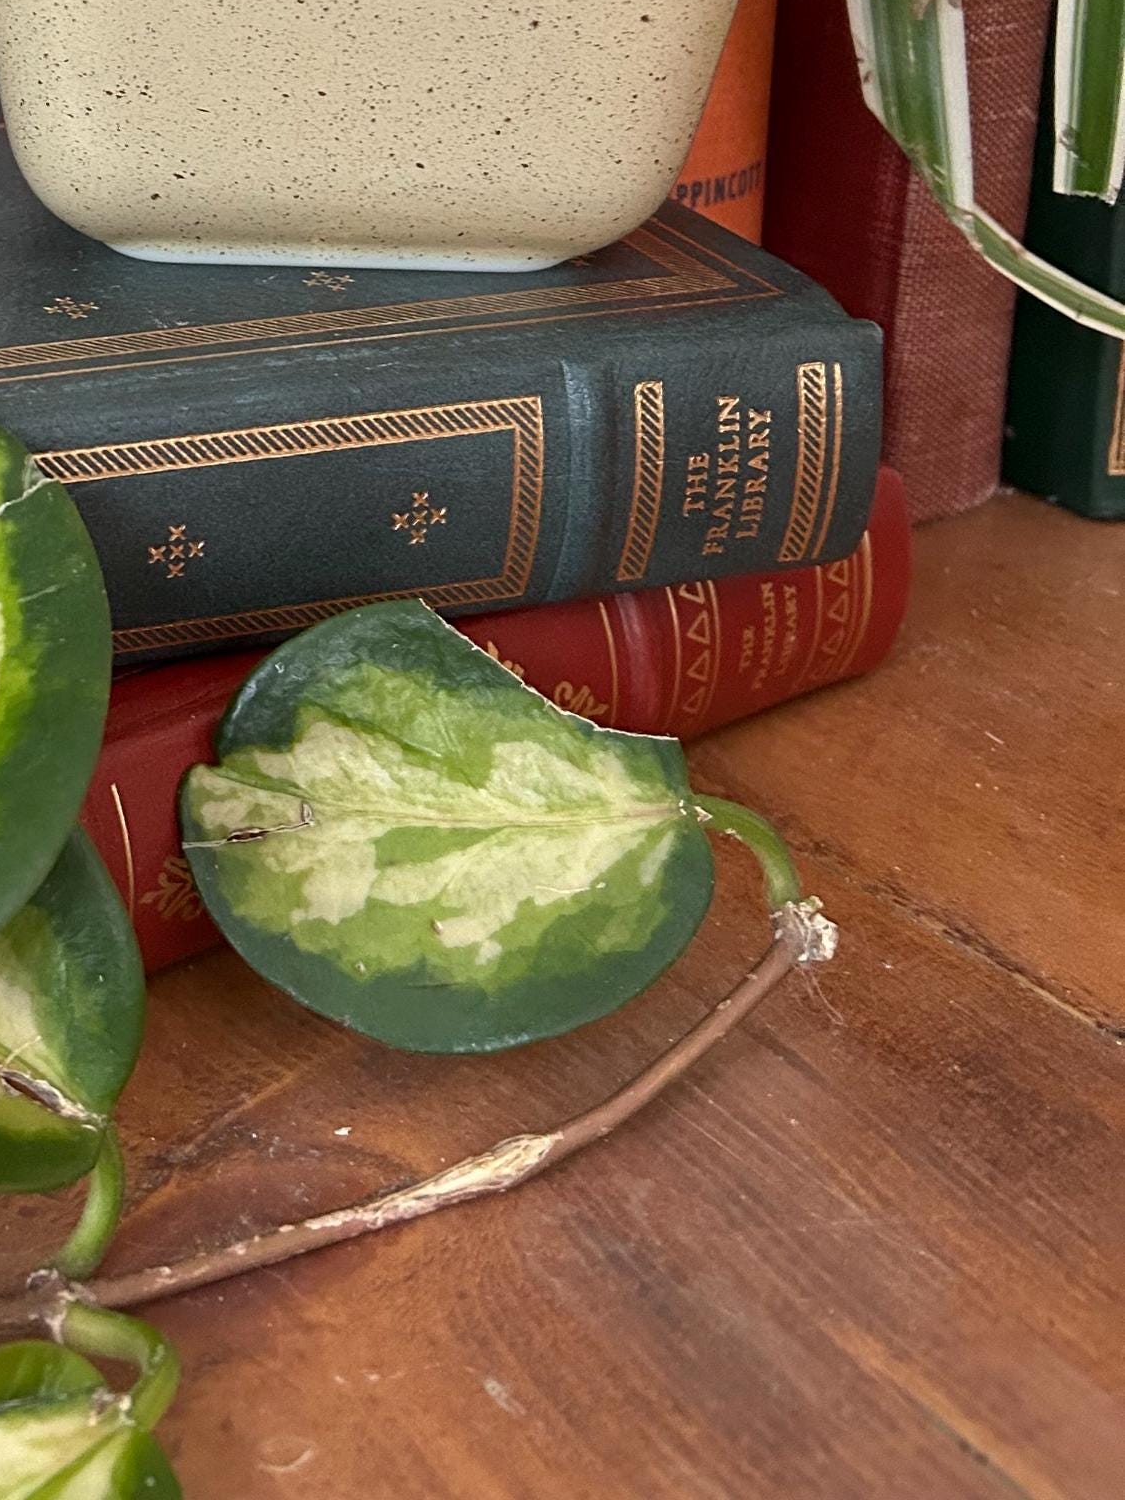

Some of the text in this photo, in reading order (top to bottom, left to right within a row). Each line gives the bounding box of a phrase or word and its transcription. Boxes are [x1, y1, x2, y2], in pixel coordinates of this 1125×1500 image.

[676, 159, 764, 209] PPINCOTT
[682, 451, 711, 517] THE
[701, 394, 741, 556] FRANKLIN
[735, 407, 773, 540] LIBRARY
